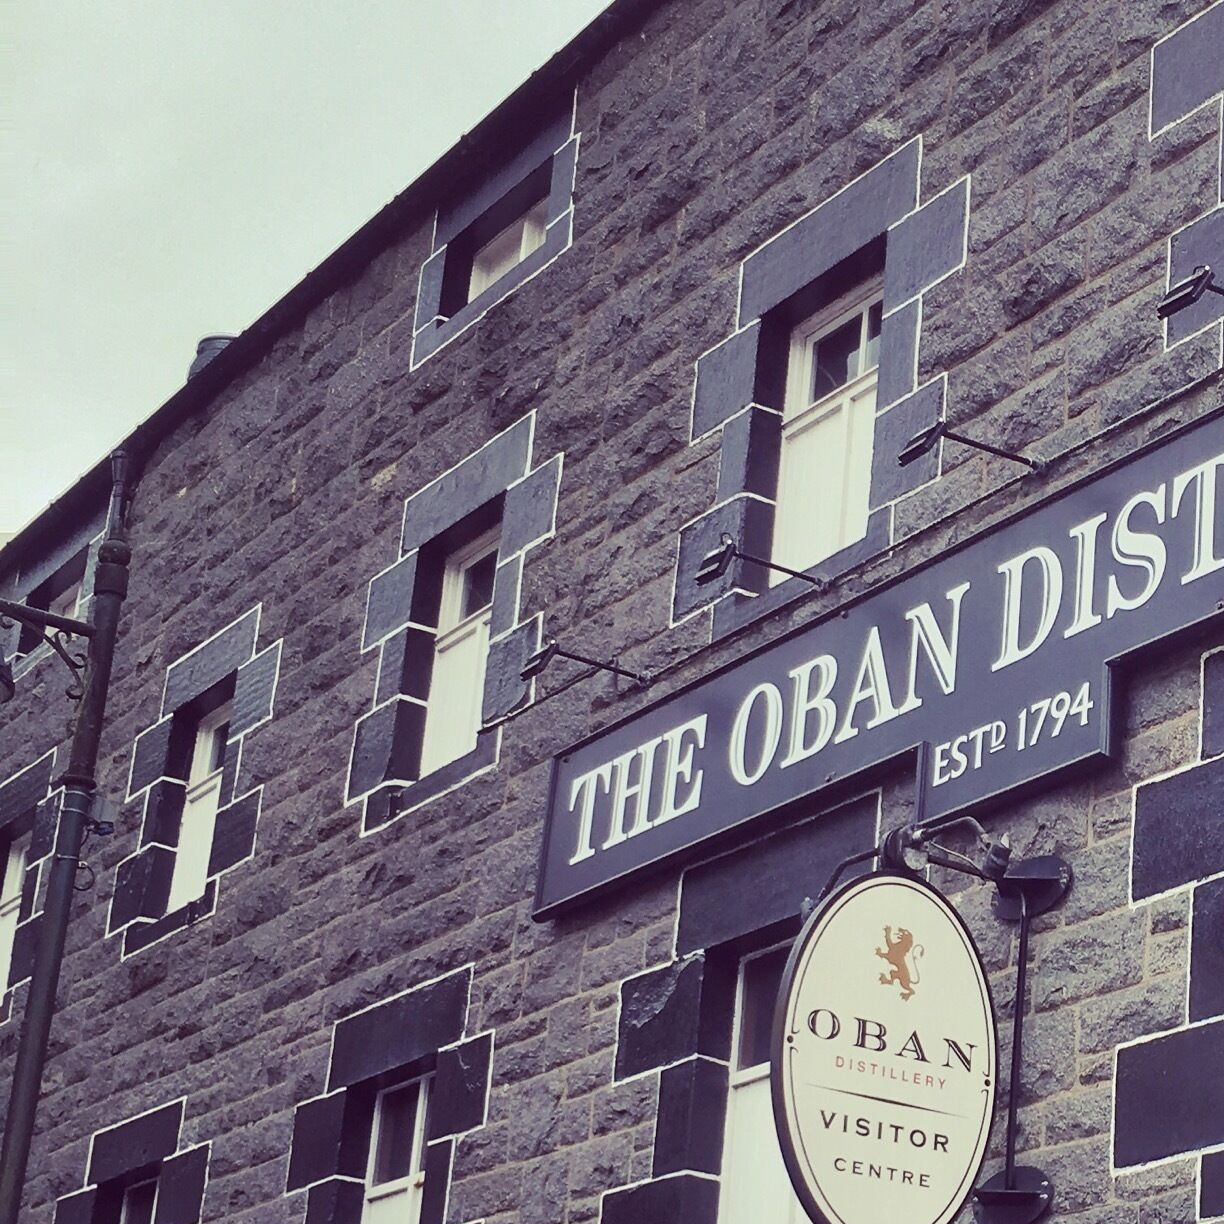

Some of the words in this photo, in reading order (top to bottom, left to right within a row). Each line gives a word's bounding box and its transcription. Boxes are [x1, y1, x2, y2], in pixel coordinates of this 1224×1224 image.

[568, 714, 708, 867] THE
[729, 581, 970, 786] OBAN
[1017, 681, 1094, 752] 1794
[807, 1008, 977, 1073] OBAN
[836, 1056, 947, 1090] DISTILLERY
[820, 1110, 950, 1153] VISITOR
[834, 1157, 931, 1188] CENTRE
